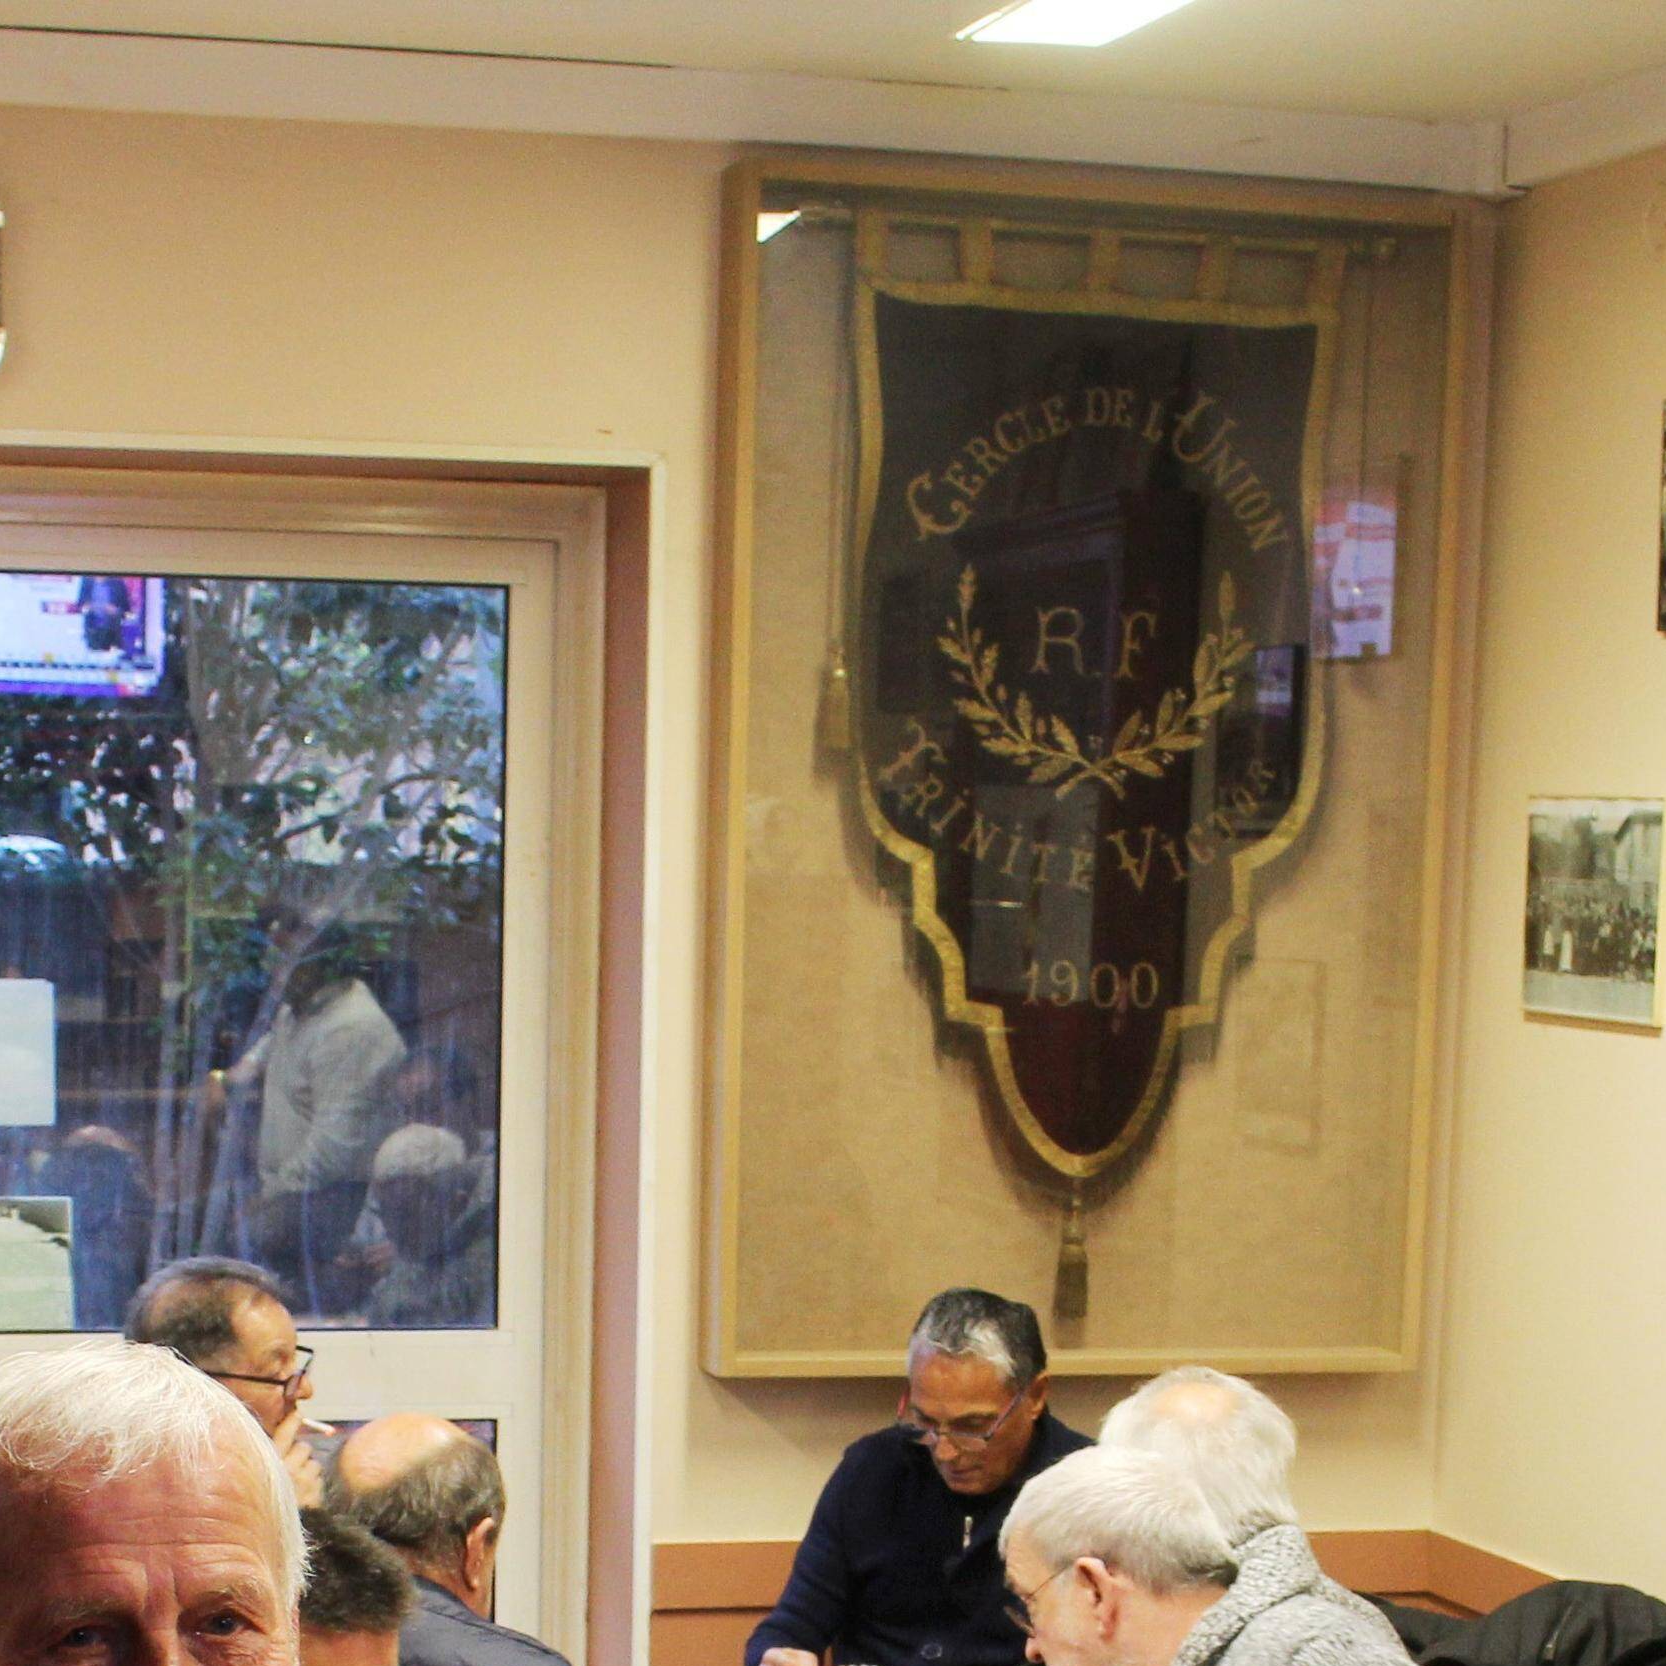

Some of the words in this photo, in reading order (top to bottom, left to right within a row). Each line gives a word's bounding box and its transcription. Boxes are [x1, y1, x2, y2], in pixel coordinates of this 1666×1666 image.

[906, 396, 1072, 542] CERCLE
[1085, 386, 1134, 429] DE
[1106, 757, 1277, 891] VICTOR
[1023, 958, 1159, 1010] 1900
